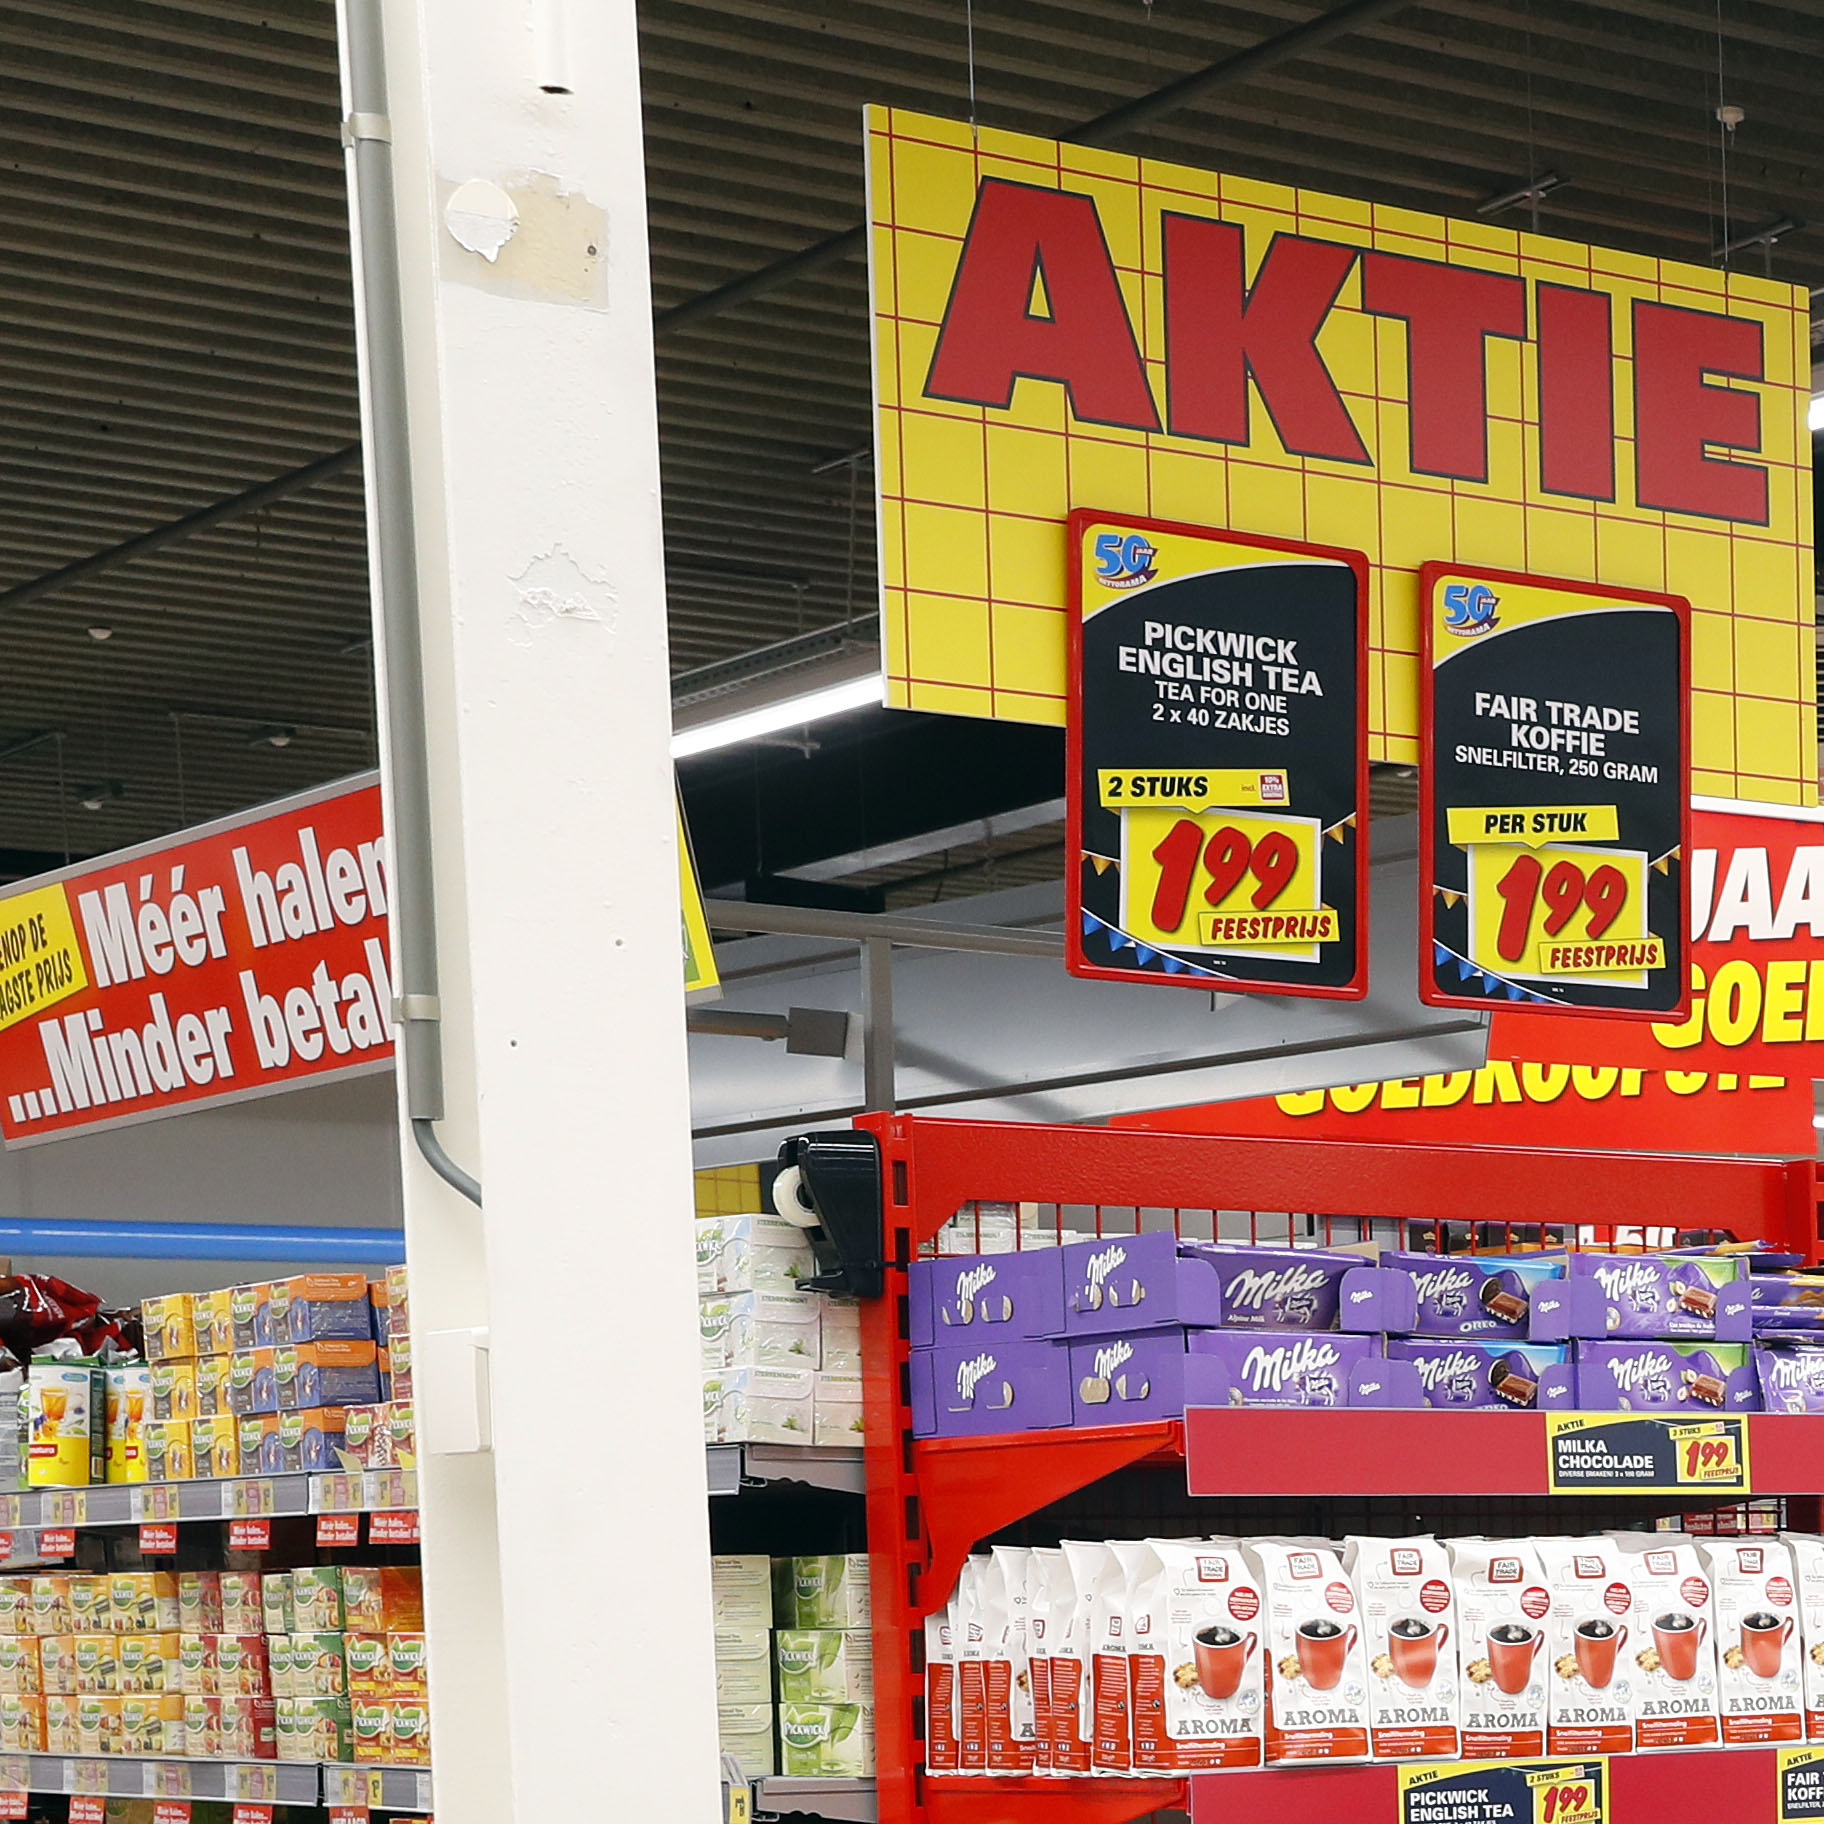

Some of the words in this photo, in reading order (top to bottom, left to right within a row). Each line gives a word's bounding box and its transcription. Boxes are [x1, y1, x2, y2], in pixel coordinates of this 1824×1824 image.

[923, 175, 1770, 527] AKTIE
[1095, 534, 1153, 578] 50
[1443, 584, 1494, 626] 50
[1144, 621, 1298, 665] PICKWICK
[1118, 646, 1253, 688] ENGLISH
[1261, 665, 1324, 697] TEA
[1155, 680, 1195, 703] TEA
[1200, 687, 1240, 709] FOR
[1245, 692, 1288, 714] ONE
[1475, 691, 1538, 722] FAIR
[1545, 700, 1640, 735] TRADE
[1152, 703, 1165, 721] 2
[1170, 709, 1182, 723] x
[1187, 708, 1209, 727] 40
[1215, 710, 1290, 736] ZAKJES
[1511, 723, 1606, 757] KOFFIE
[1455, 745, 1564, 776] SNELFILTER,
[1568, 758, 1599, 777] 250
[1603, 761, 1659, 784] GRAM
[1107, 776, 1123, 798] 2
[1130, 776, 1208, 798] STUKS
[1485, 814, 1525, 834] PER
[1531, 813, 1587, 833] STUK
[1151, 818, 1299, 933] 199
[1496, 854, 1628, 962] 199
[29, 912, 47, 952] DE
[79, 865, 231, 989] Méér
[1211, 915, 1331, 940] FEESTPRIJS
[35, 947, 73, 998] PRIJS
[1550, 943, 1658, 969] FEESTPRIJS
[8, 1007, 233, 1124] ...Minder
[1225, 1263, 1331, 1308] Milka
[1594, 1262, 1661, 1301] Milka
[1241, 1338, 1340, 1391] Milka
[1607, 1351, 1674, 1389] Milka
[1557, 1419, 1585, 1432] AKTIE
[1557, 1439, 1607, 1453] MILKA
[1558, 1455, 1654, 1469] CHOCOLADE
[1686, 1440, 1729, 1478] 199
[780, 1647, 814, 1662] PICKWICK
[1642, 1698, 1711, 1715] AROMA
[1728, 1696, 1796, 1712] AROMA
[785, 1722, 826, 1737] PICKWICK
[1787, 1752, 1813, 1766] AKTIE
[1408, 1770, 1438, 1785] AKTIE
[1536, 1772, 1560, 1782] STUKS
[1787, 1772, 1820, 1786] FAIR
[1410, 1789, 1489, 1806] PICKWICK
[1410, 1806, 1483, 1822] ENGLISH
[1485, 1804, 1514, 1818] TEA
[1544, 1786, 1588, 1823] 199
